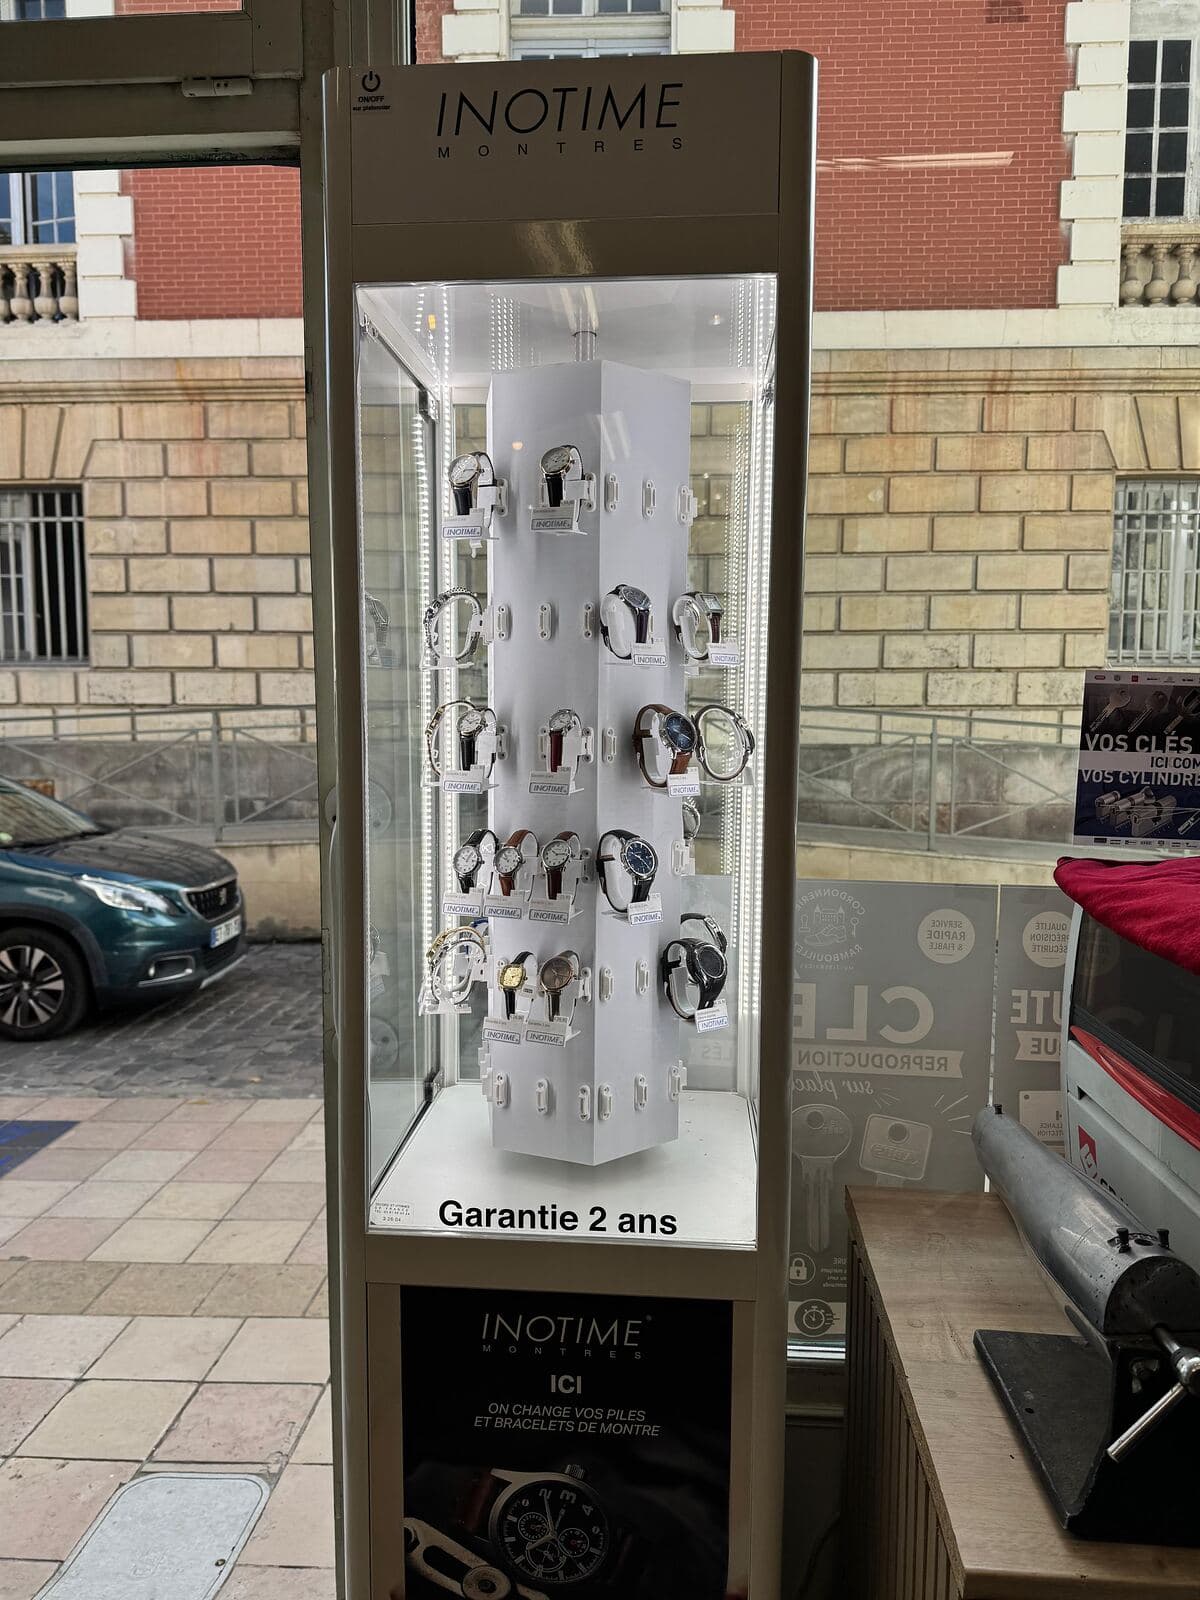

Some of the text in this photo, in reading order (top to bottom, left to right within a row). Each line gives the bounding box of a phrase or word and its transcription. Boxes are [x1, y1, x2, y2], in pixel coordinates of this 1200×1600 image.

[437, 83, 683, 136] INOTIME
[437, 138, 683, 159] MONTRES
[1085, 731, 1193, 754] VOS CLÉS
[1151, 756, 1168, 769] ICI
[1081, 770, 1200, 787] VOS CYLINDRE
[533, 785, 564, 793] INOTIME
[488, 907, 517, 916] INOTIME
[533, 912, 563, 920] INOTIME
[487, 1032, 516, 1041] INOTIME
[530, 1034, 559, 1043] INOTIME
[438, 1199, 678, 1236] Garantie 2 ans
[482, 1313, 642, 1347] INOTIME
[482, 1344, 642, 1360] MONTRES
[550, 1374, 582, 1394] ICI
[488, 1402, 646, 1422] ON CHANGE VOS PILES
[473, 1416, 661, 1437] ET BRACELETS DE MONTRE
